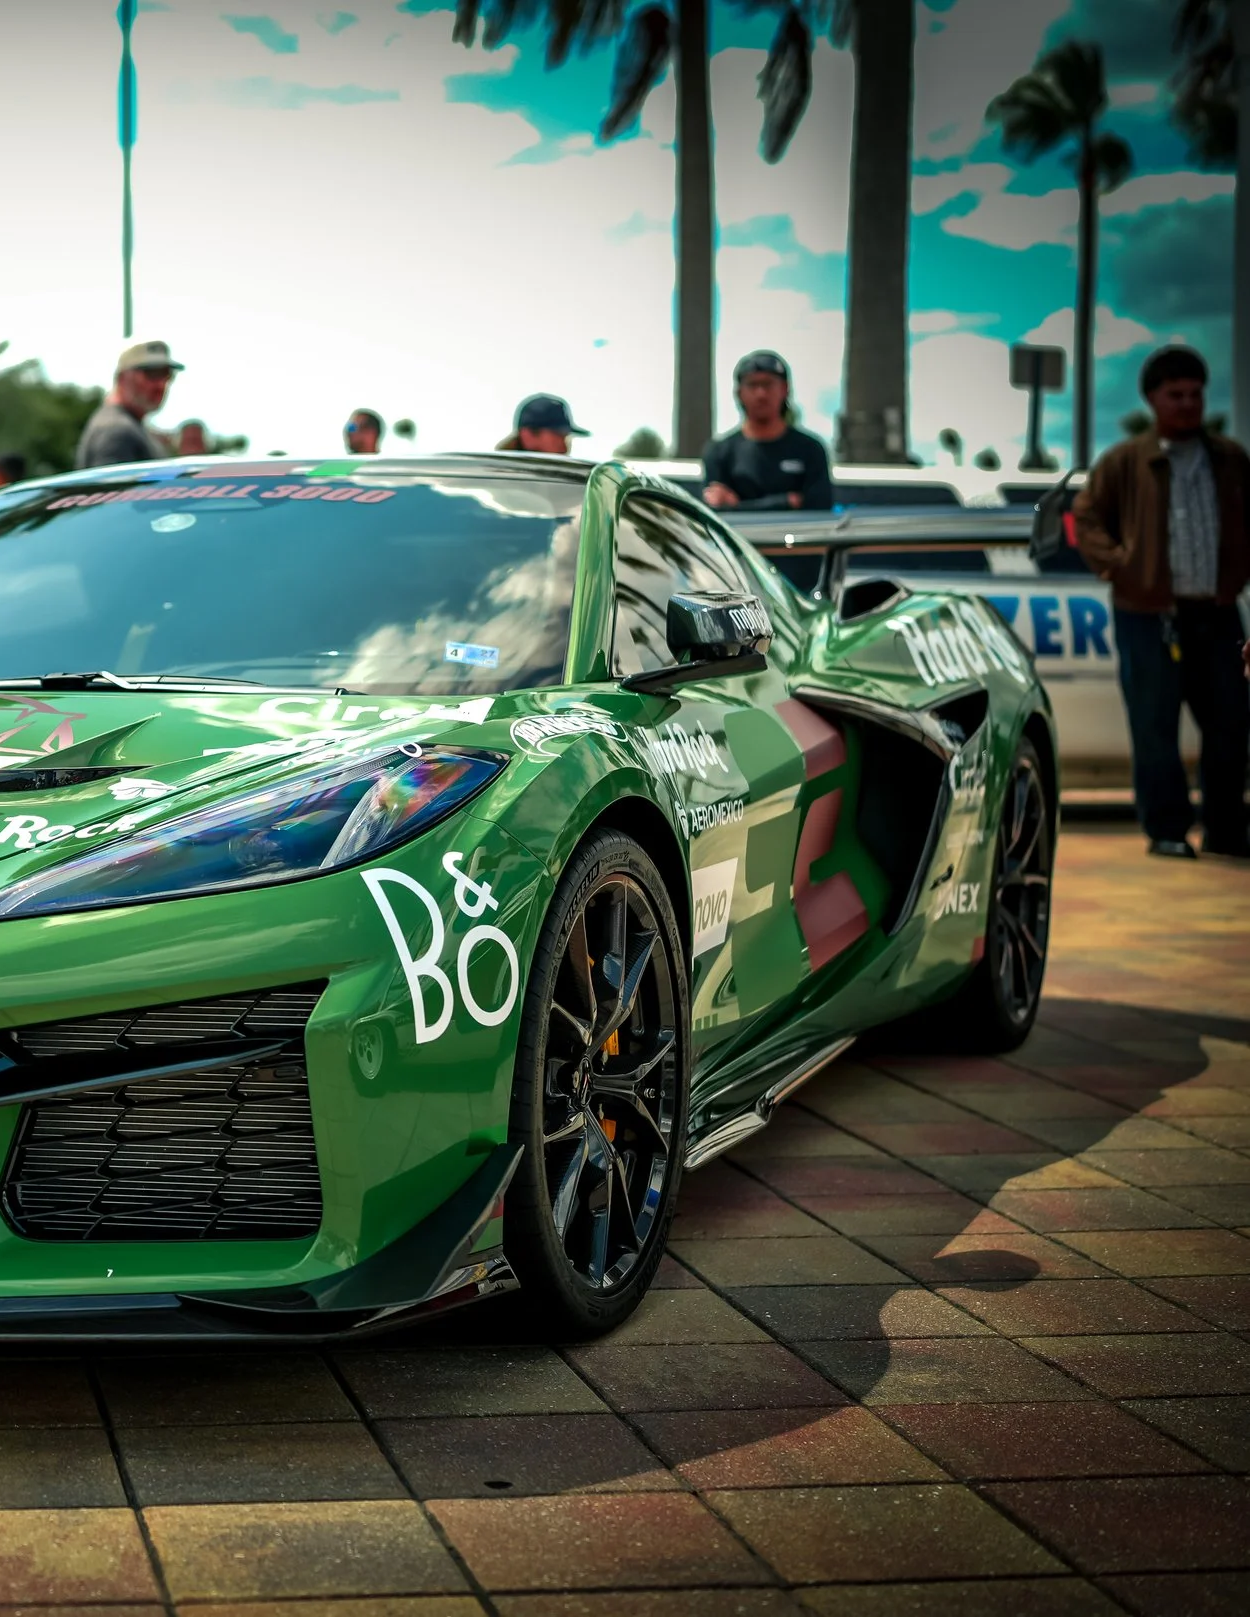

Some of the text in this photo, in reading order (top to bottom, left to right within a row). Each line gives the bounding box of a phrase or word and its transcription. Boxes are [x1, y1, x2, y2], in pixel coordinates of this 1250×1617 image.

[46, 484, 397, 509] GUMBALL 3000
[673, 719, 730, 779] Rock
[691, 800, 744, 833] AEROMEXICO
